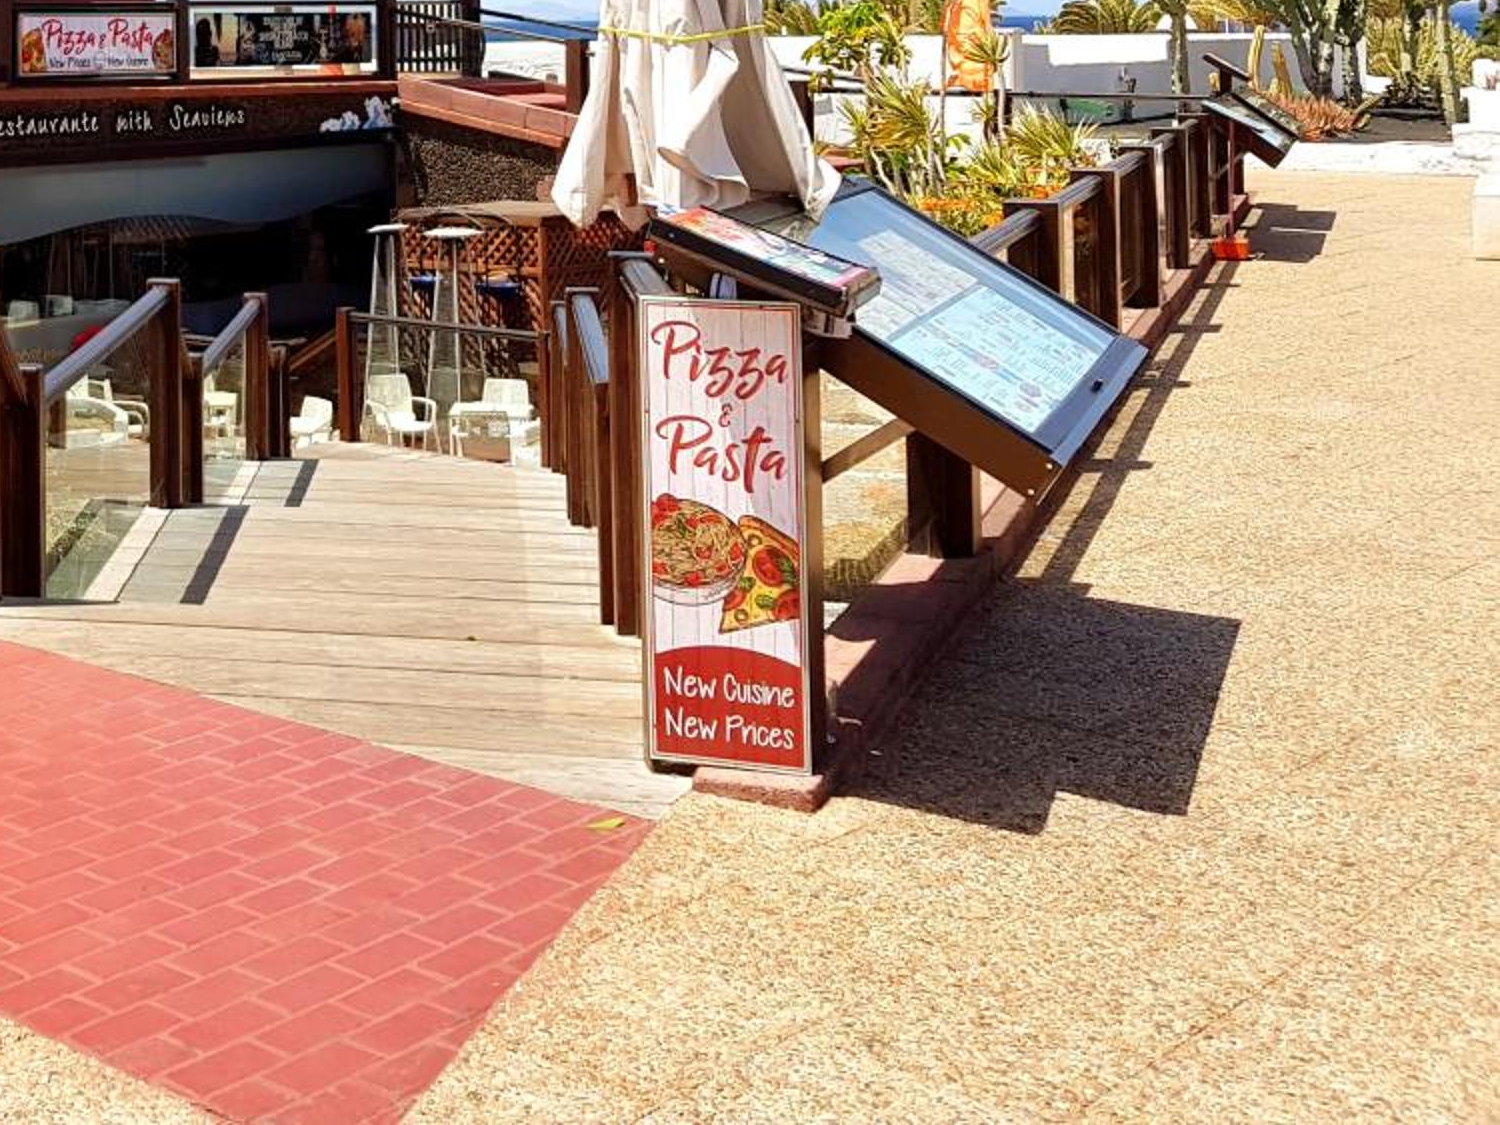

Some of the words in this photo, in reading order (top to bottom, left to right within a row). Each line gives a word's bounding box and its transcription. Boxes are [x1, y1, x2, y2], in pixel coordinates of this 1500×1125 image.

[41, 18, 96, 56] Pizza
[107, 18, 153, 54] Pasta
[116, 110, 154, 133] with
[169, 104, 246, 131] Seaviews
[650, 320, 787, 401] Pizza
[655, 415, 786, 493] Pasta
[664, 666, 716, 700] New
[724, 671, 795, 709] Cuisine
[665, 708, 717, 740] New
[725, 713, 795, 751] Prices
